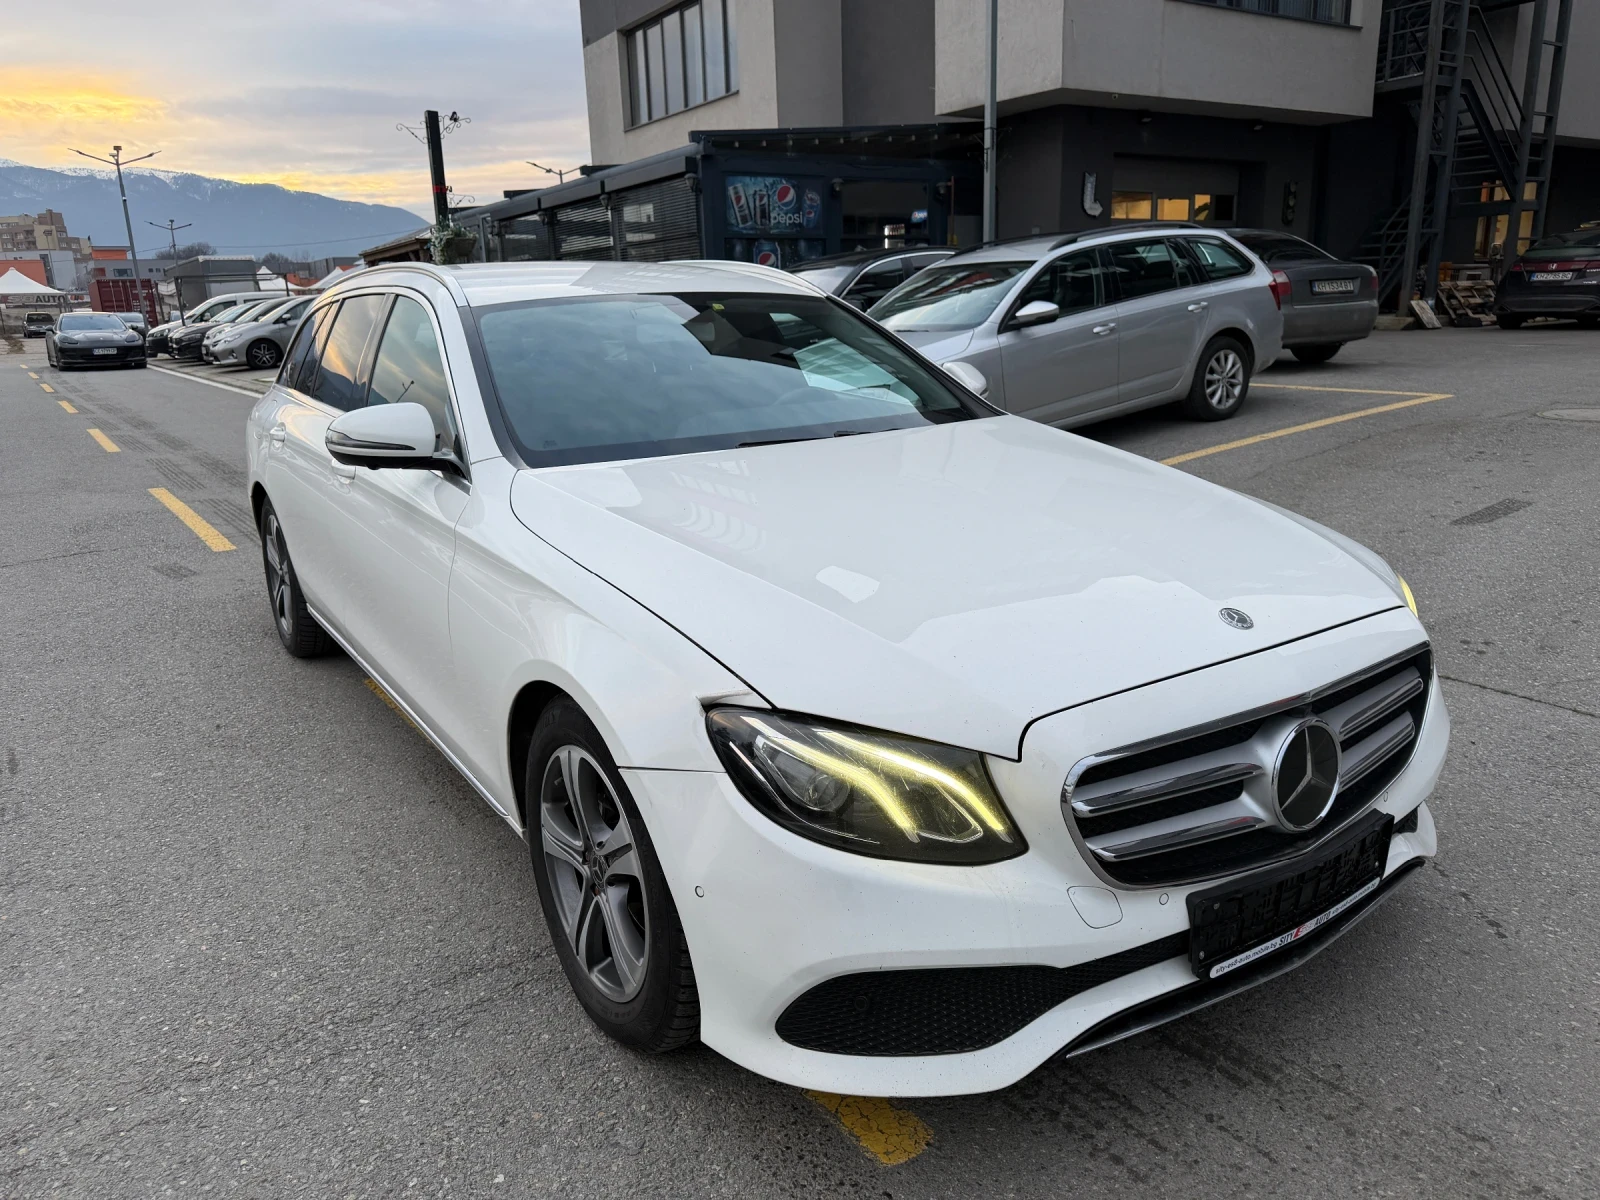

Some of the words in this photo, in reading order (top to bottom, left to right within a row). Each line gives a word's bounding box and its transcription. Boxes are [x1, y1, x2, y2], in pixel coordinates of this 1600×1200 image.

[771, 212, 803, 226] pepsi
[36, 295, 66, 304] AUTO
[1279, 931, 1294, 946] SITY
[1314, 911, 1332, 928] AUTO
